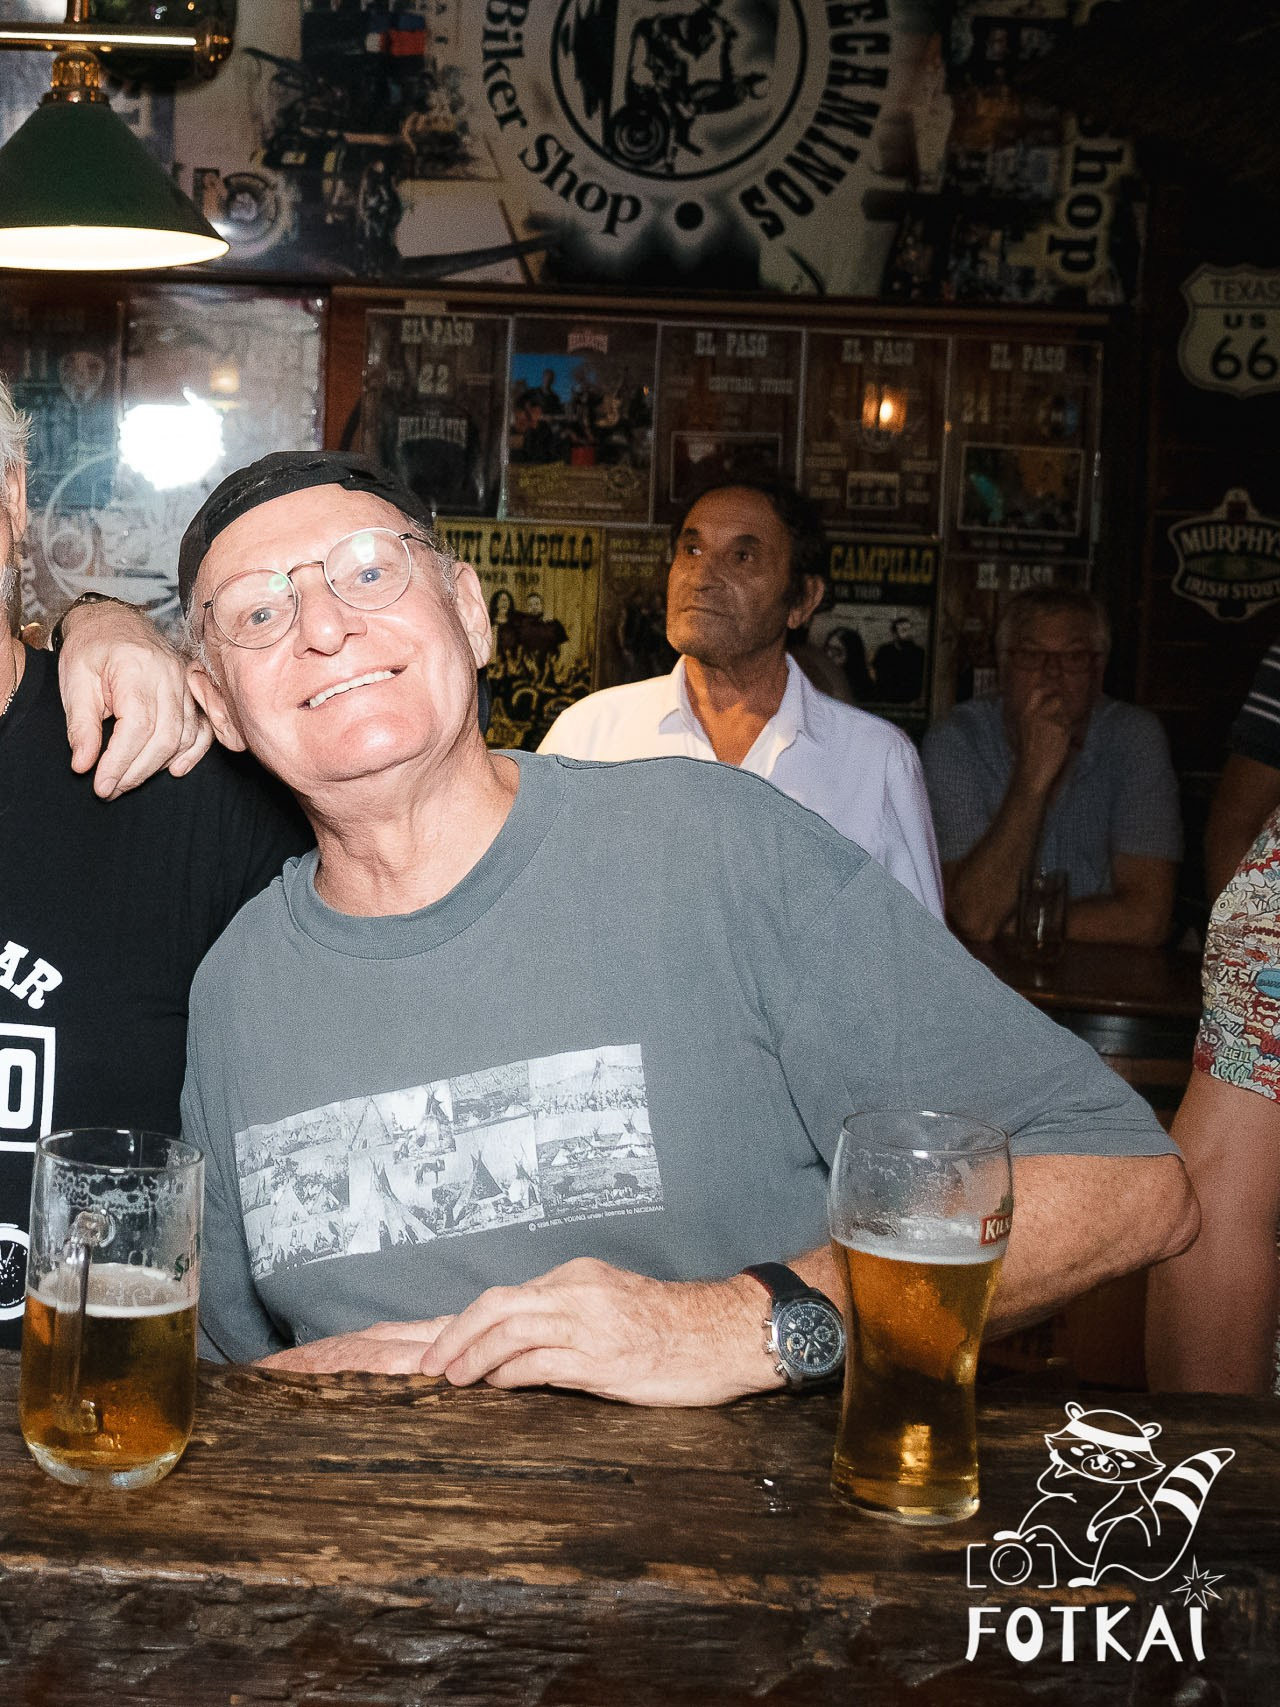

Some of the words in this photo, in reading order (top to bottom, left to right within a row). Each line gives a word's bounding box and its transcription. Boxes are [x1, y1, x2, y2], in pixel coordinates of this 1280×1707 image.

[519, 133, 642, 237] Shop
[694, 331, 716, 356] EL
[726, 332, 768, 358] PASO
[842, 338, 864, 363] EL
[873, 340, 915, 366] PASO
[989, 343, 1013, 370] EL
[1022, 344, 1066, 372] PASO
[1211, 336, 1279, 381] 66
[418, 363, 449, 393] 22
[489, 532, 593, 570] CAMPILLO
[830, 545, 934, 584] CAMPILLO
[977, 563, 1000, 589] EL
[1223, 1047, 1251, 1062] HELL
[563, 1213, 586, 1223] YOUNG
